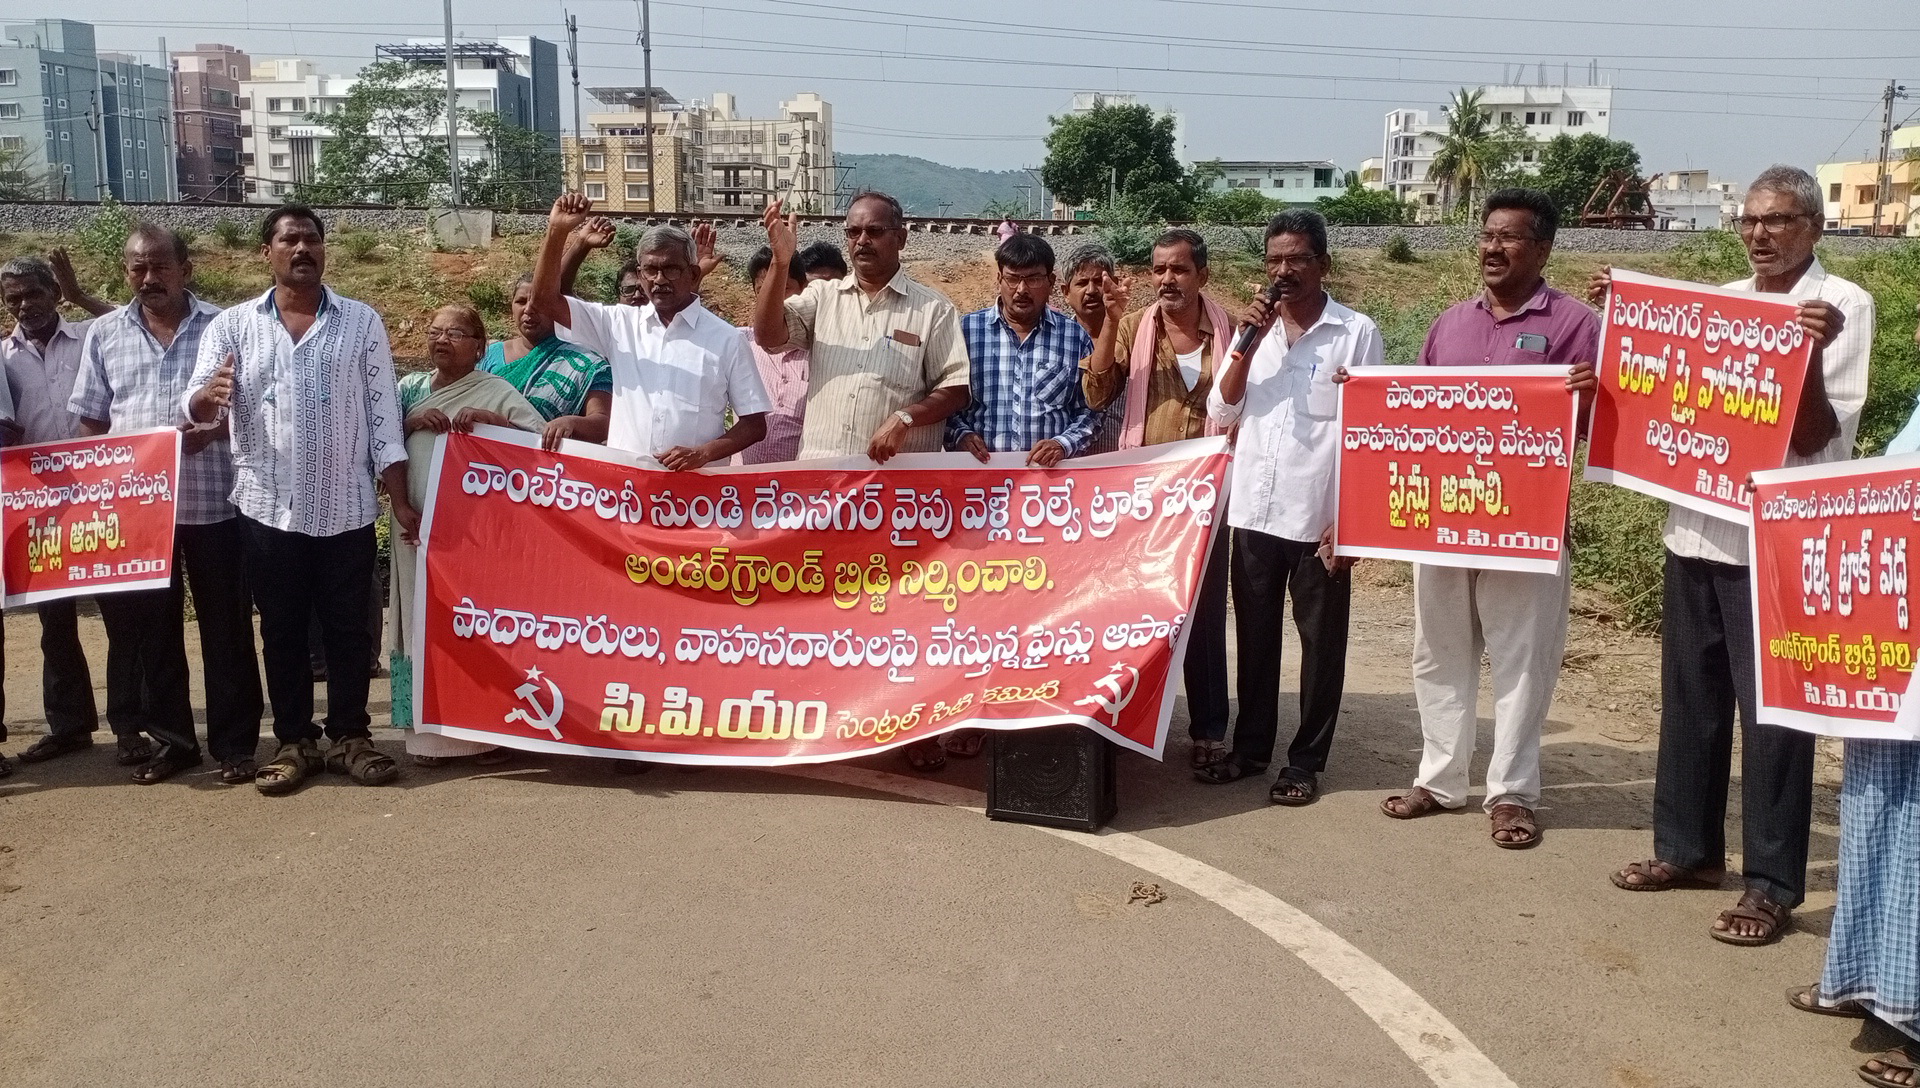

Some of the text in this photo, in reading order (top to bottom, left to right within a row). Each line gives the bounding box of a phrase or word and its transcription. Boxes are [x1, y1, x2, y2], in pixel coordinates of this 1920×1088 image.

[1612, 294, 1804, 355] సింగునగర్ ప్రాంతంలో
[1386, 380, 1519, 414] పాదాచారులు,
[30, 444, 135, 475] పాదాచారులు,
[1344, 419, 1568, 468] వాహనదారులపై వేస్తున్న
[1646, 419, 1730, 467] నిర్మించాలి
[118, 469, 172, 505] వేస్తున్న
[461, 461, 1216, 546] వాంబేకాలనీ నుండి దేవినగర్ వైపు వెళ్లే రైల్వే ట్రాక్ వద్ద
[1439, 464, 1510, 516] ఆపాలి.
[1819, 488, 1856, 519] నుండి
[1858, 480, 1912, 516] దేవినగర్
[1436, 526, 1559, 551] సి.పి.యం
[68, 558, 166, 581] సి.పి.యం
[832, 553, 892, 613] బ్రిడ్జి
[898, 556, 1055, 613] నిర్మించాలి.
[1802, 523, 1831, 616] రైల్వే
[1838, 528, 1873, 616] ట్రాక్
[452, 597, 666, 666] పాదాచారులు,
[674, 622, 919, 683] వాహనదారులపై
[925, 618, 1020, 678] వేస్తున్న
[1844, 634, 1877, 681] బ్రిడ్జి
[599, 682, 827, 740] సి.పి.యం
[835, 703, 926, 744] సెంట్రల్
